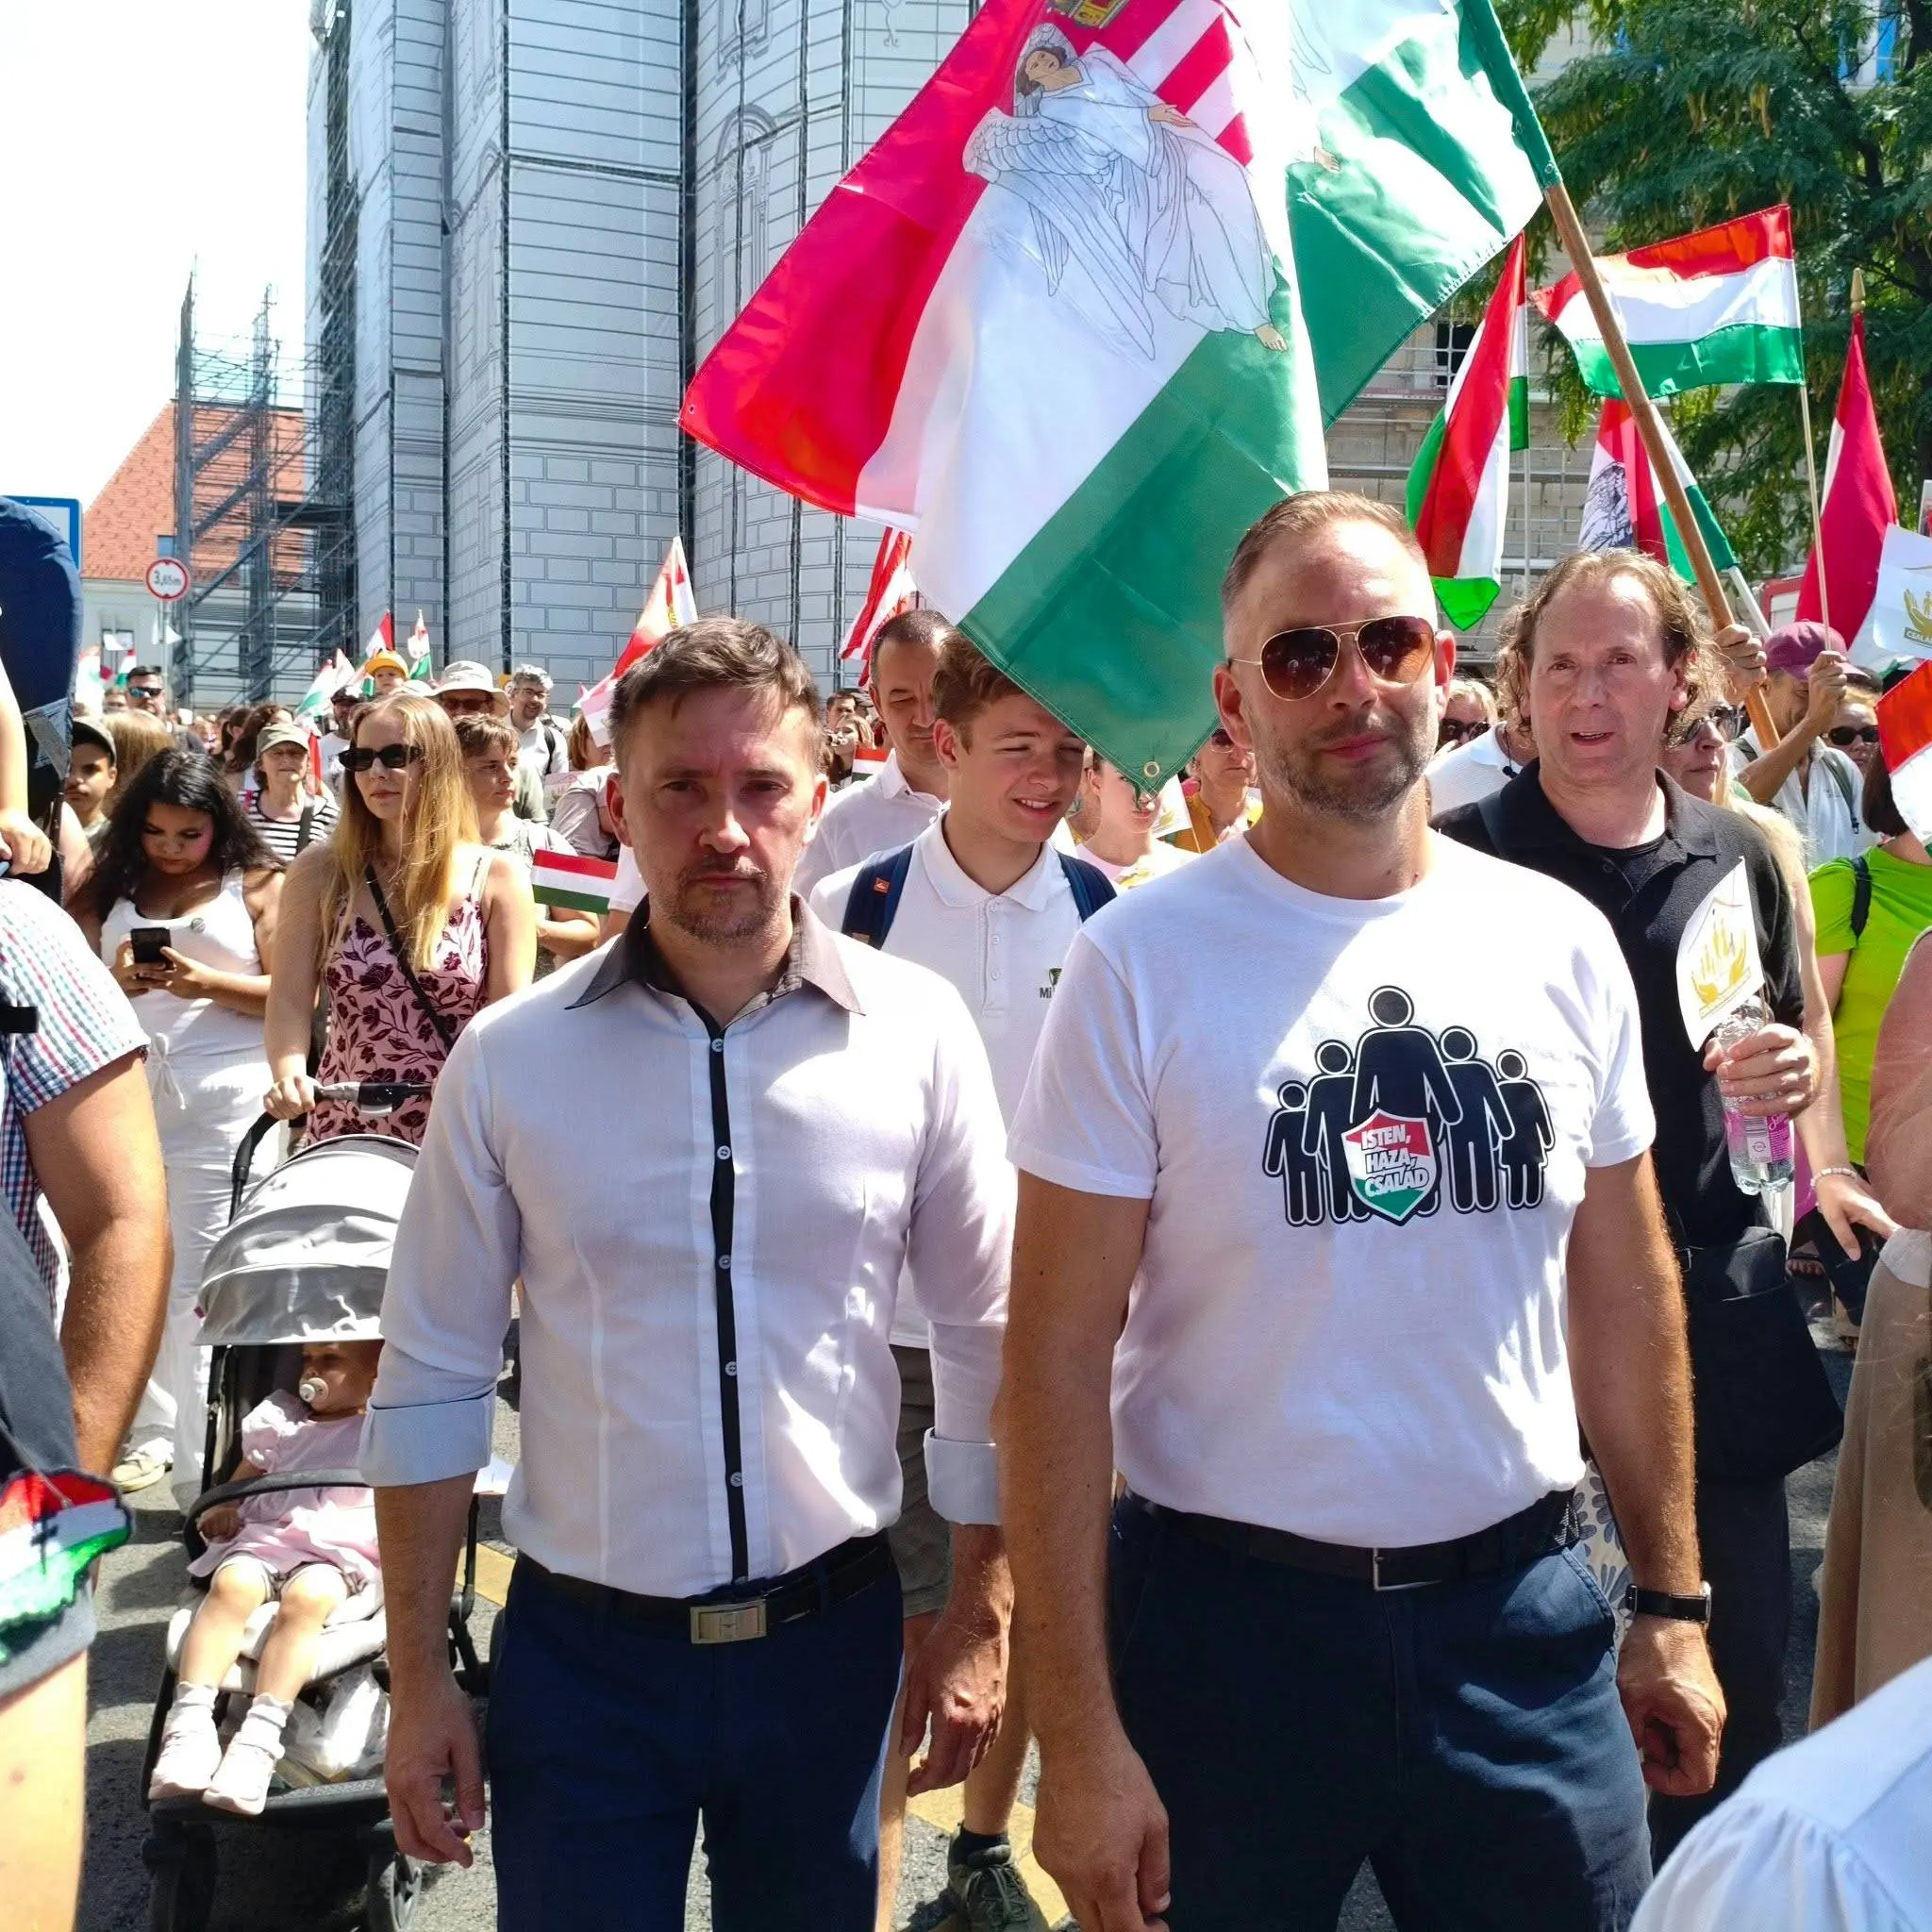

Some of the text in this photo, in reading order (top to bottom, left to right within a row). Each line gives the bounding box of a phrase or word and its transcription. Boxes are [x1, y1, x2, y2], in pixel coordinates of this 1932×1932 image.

[1361, 1124, 1411, 1149] ISTEN,
[1365, 1148, 1417, 1174] HAZA,
[1364, 1166, 1429, 1197] CSALÁD
